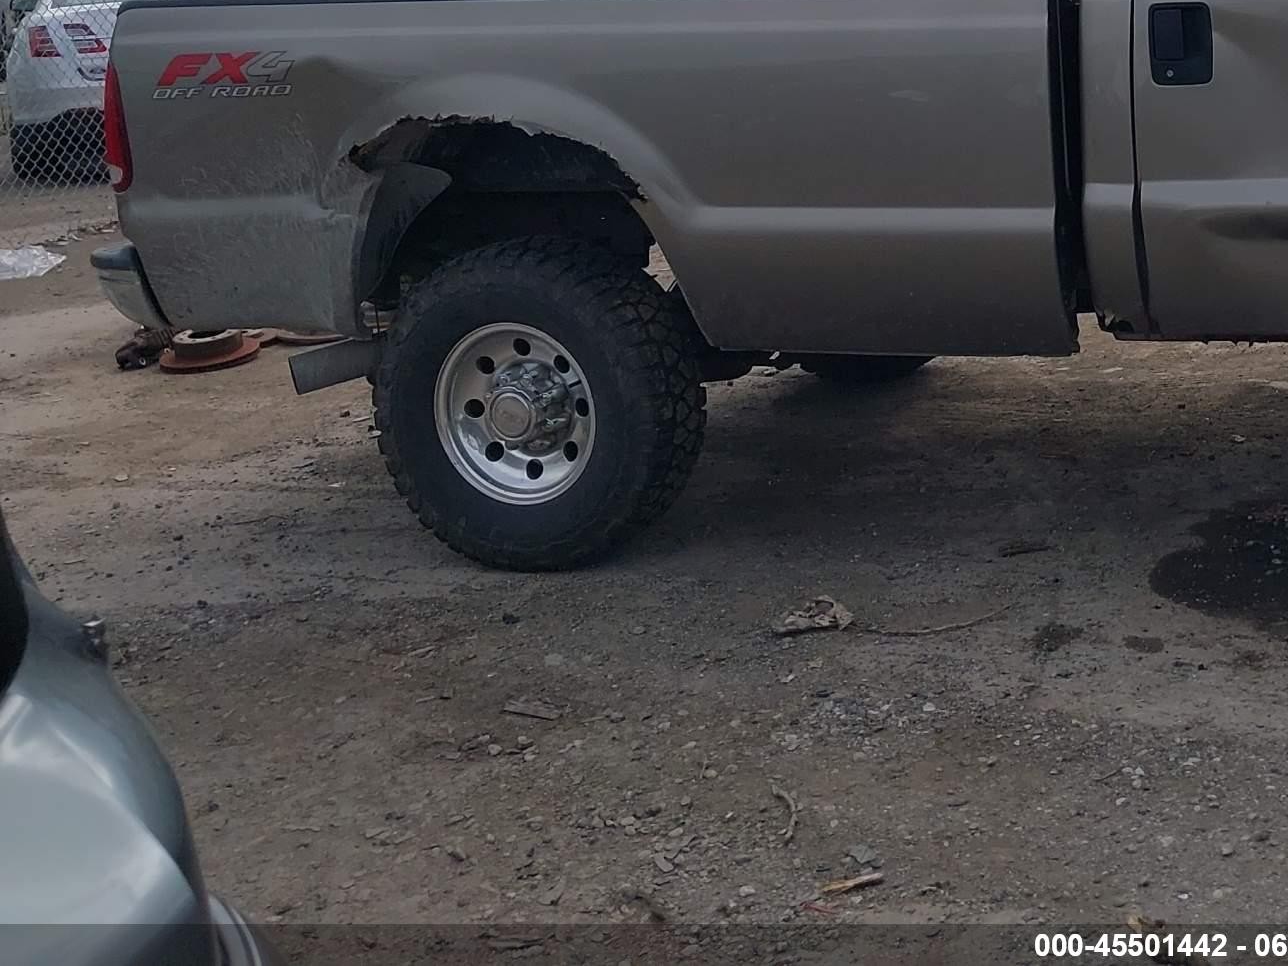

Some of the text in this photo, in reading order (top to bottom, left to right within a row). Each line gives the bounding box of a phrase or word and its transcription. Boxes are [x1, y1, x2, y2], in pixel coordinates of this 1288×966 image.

[156, 50, 296, 87] FX4
[152, 84, 292, 100] OFF ROAD
